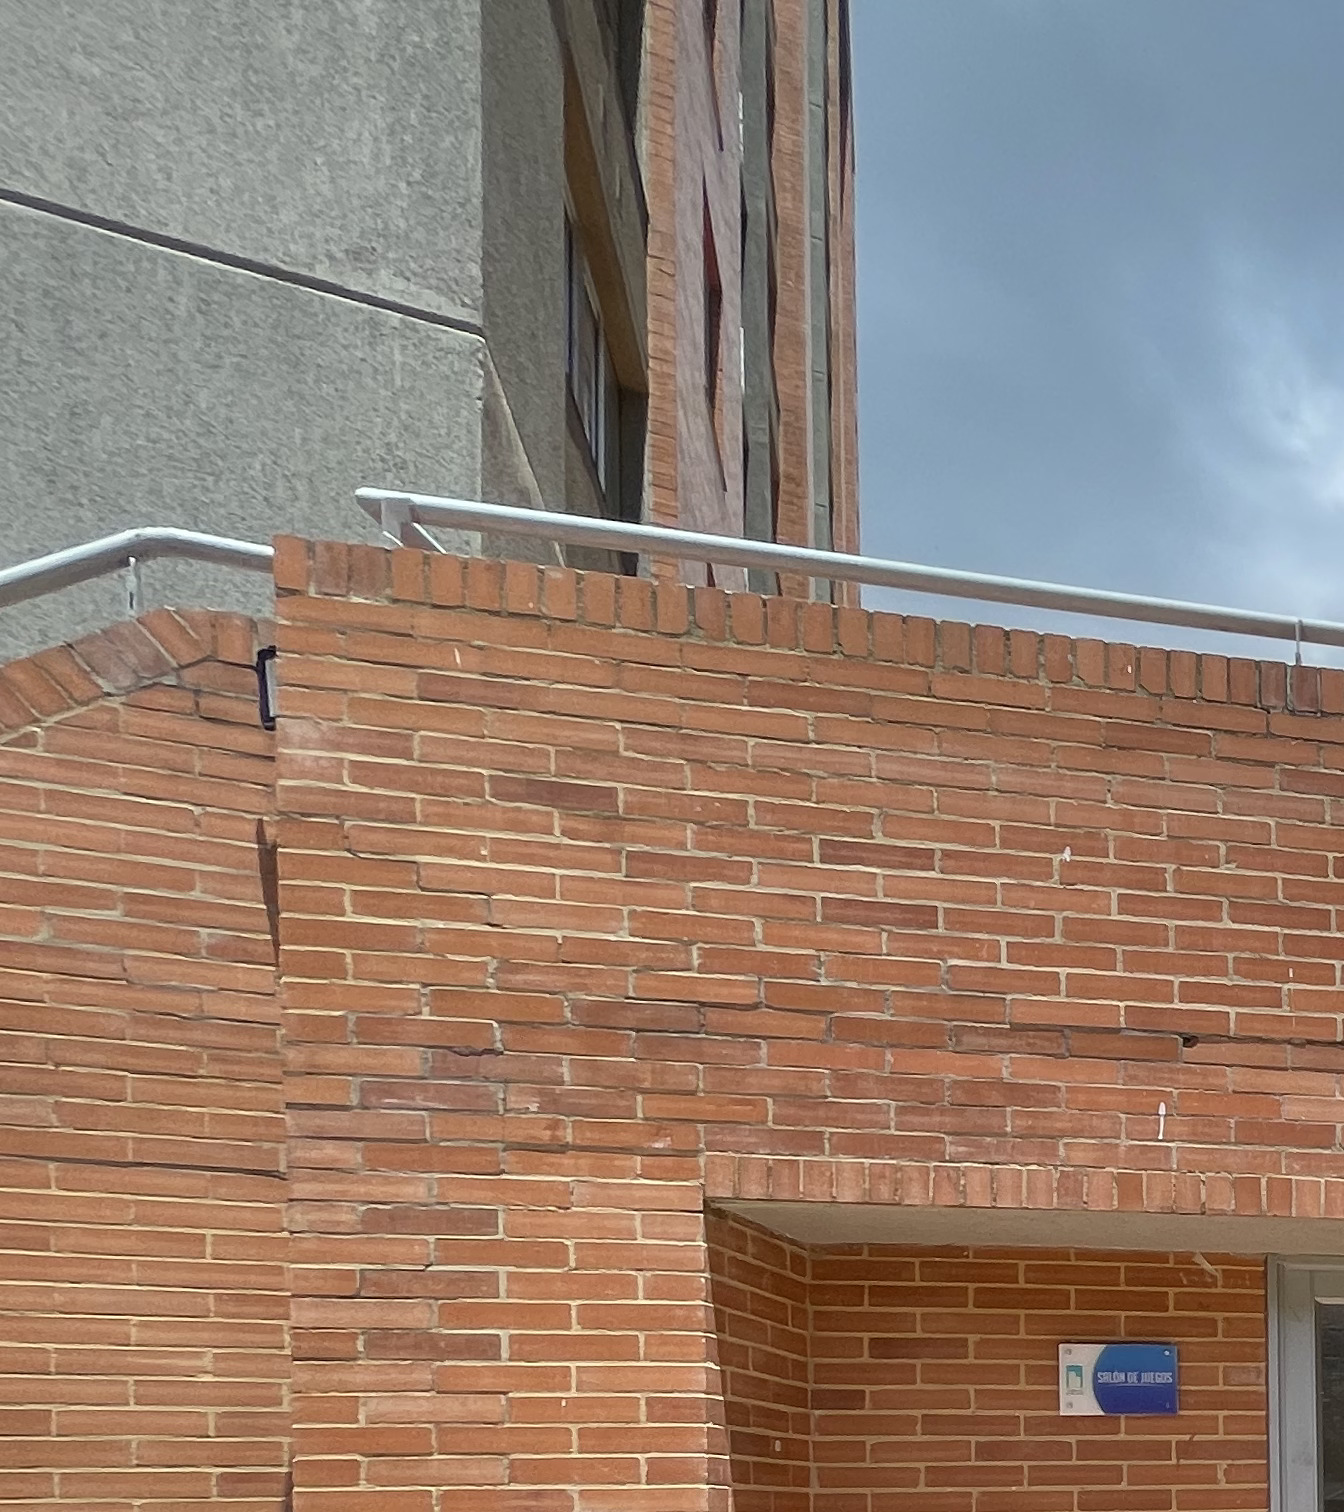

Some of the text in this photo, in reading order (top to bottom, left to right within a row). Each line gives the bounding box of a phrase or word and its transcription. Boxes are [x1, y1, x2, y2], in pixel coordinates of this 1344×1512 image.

[1097, 1371, 1173, 1383] SALÓN DE JUEGOS
